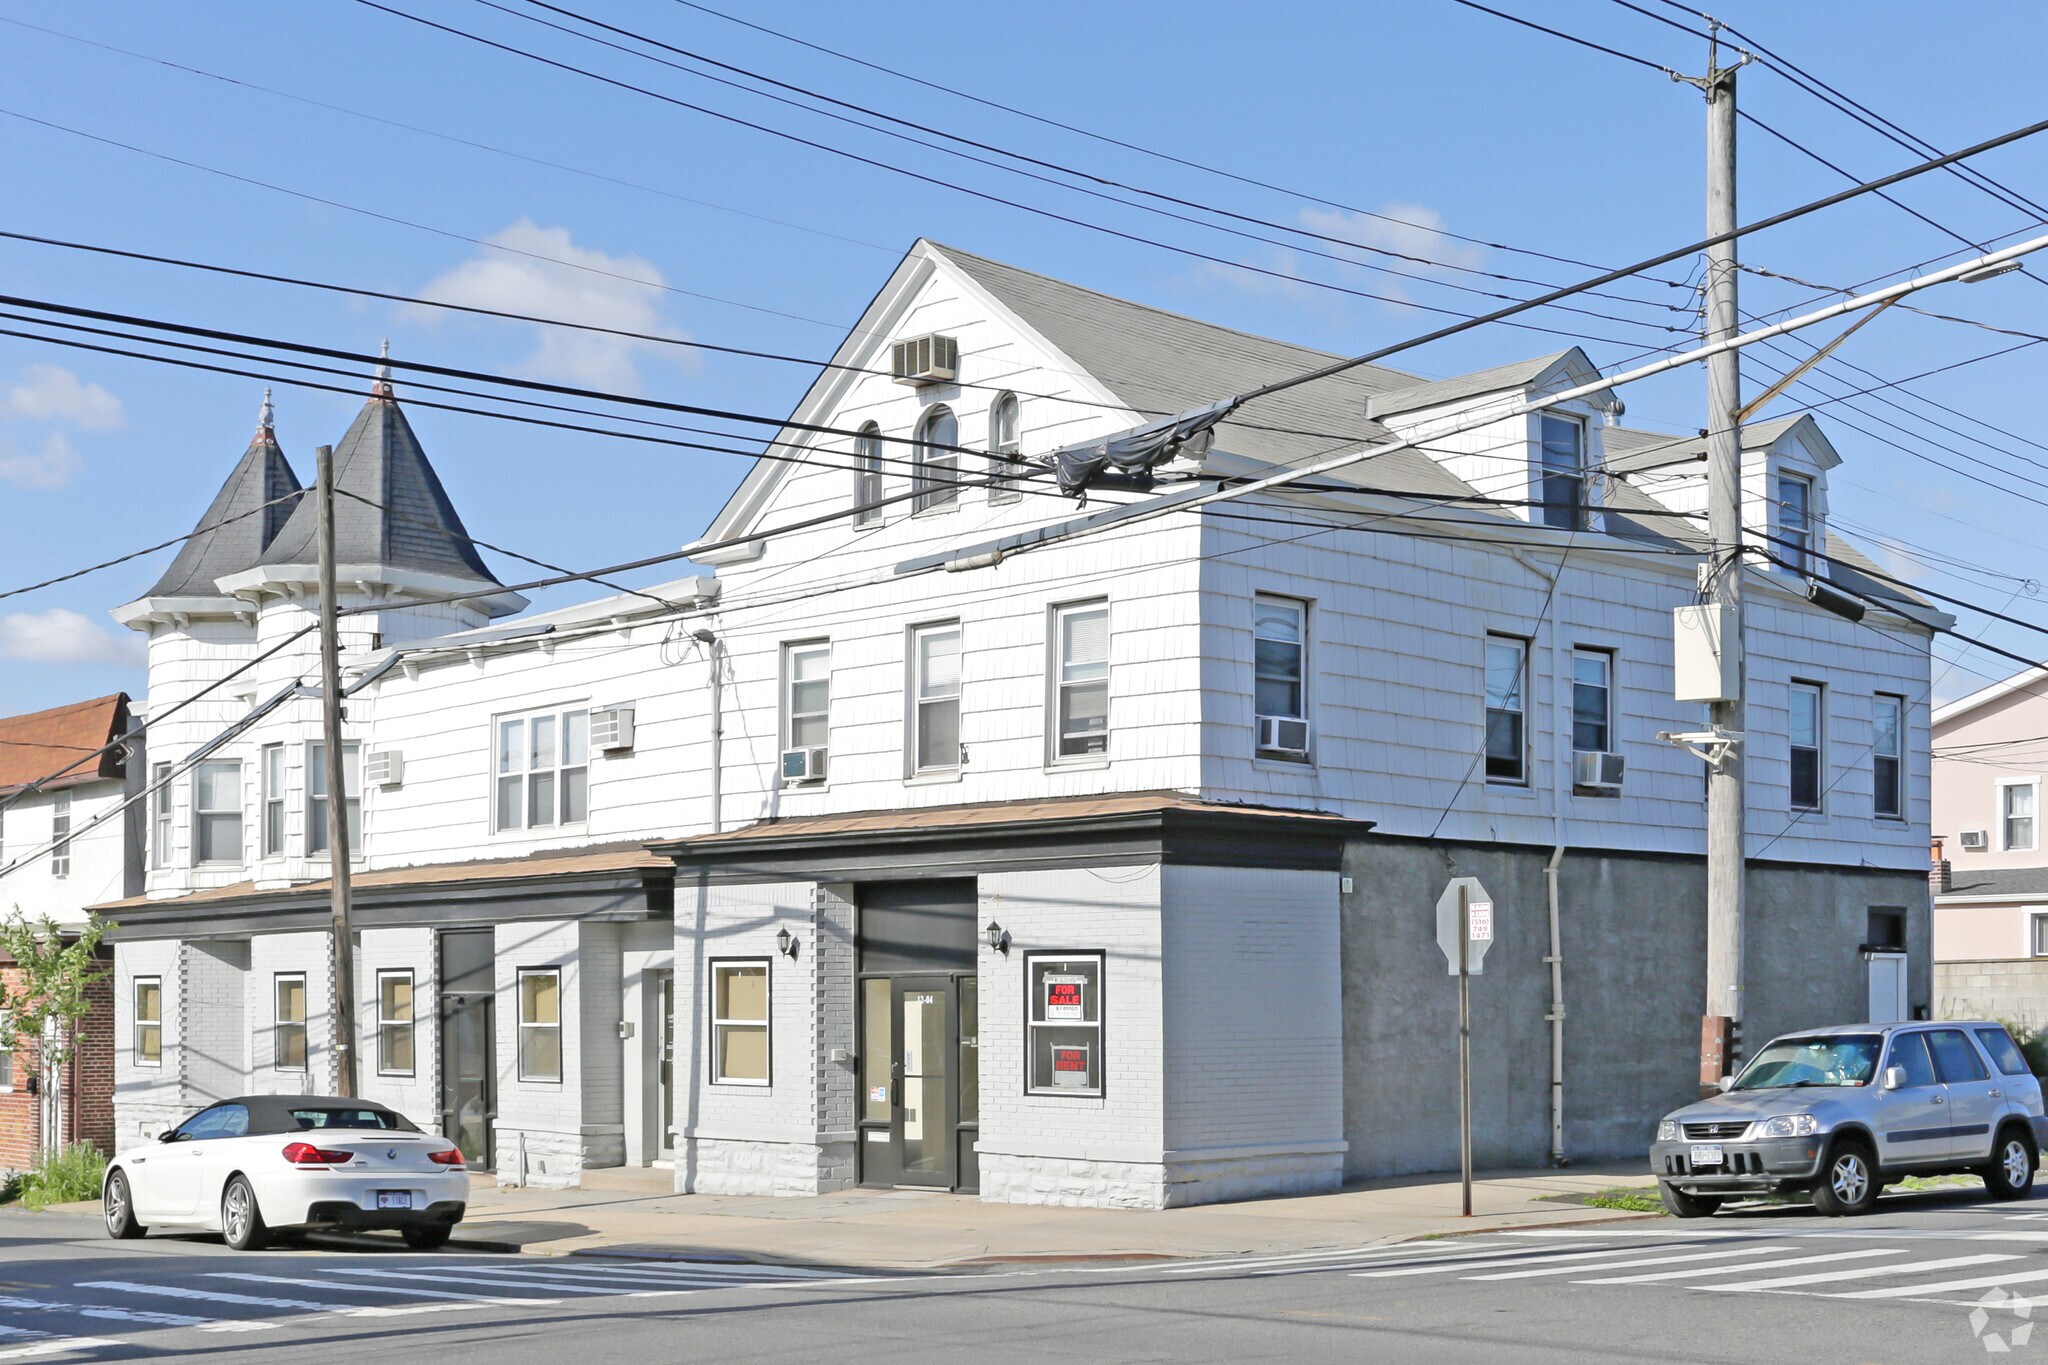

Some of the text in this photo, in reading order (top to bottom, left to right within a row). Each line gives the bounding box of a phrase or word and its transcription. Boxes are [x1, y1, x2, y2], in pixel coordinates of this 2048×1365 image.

[1055, 984, 1075, 995] FOR
[1050, 995, 1080, 1005] SALE
[1061, 1050, 1081, 1060] FOR
[1056, 1060, 1086, 1071] RENT
